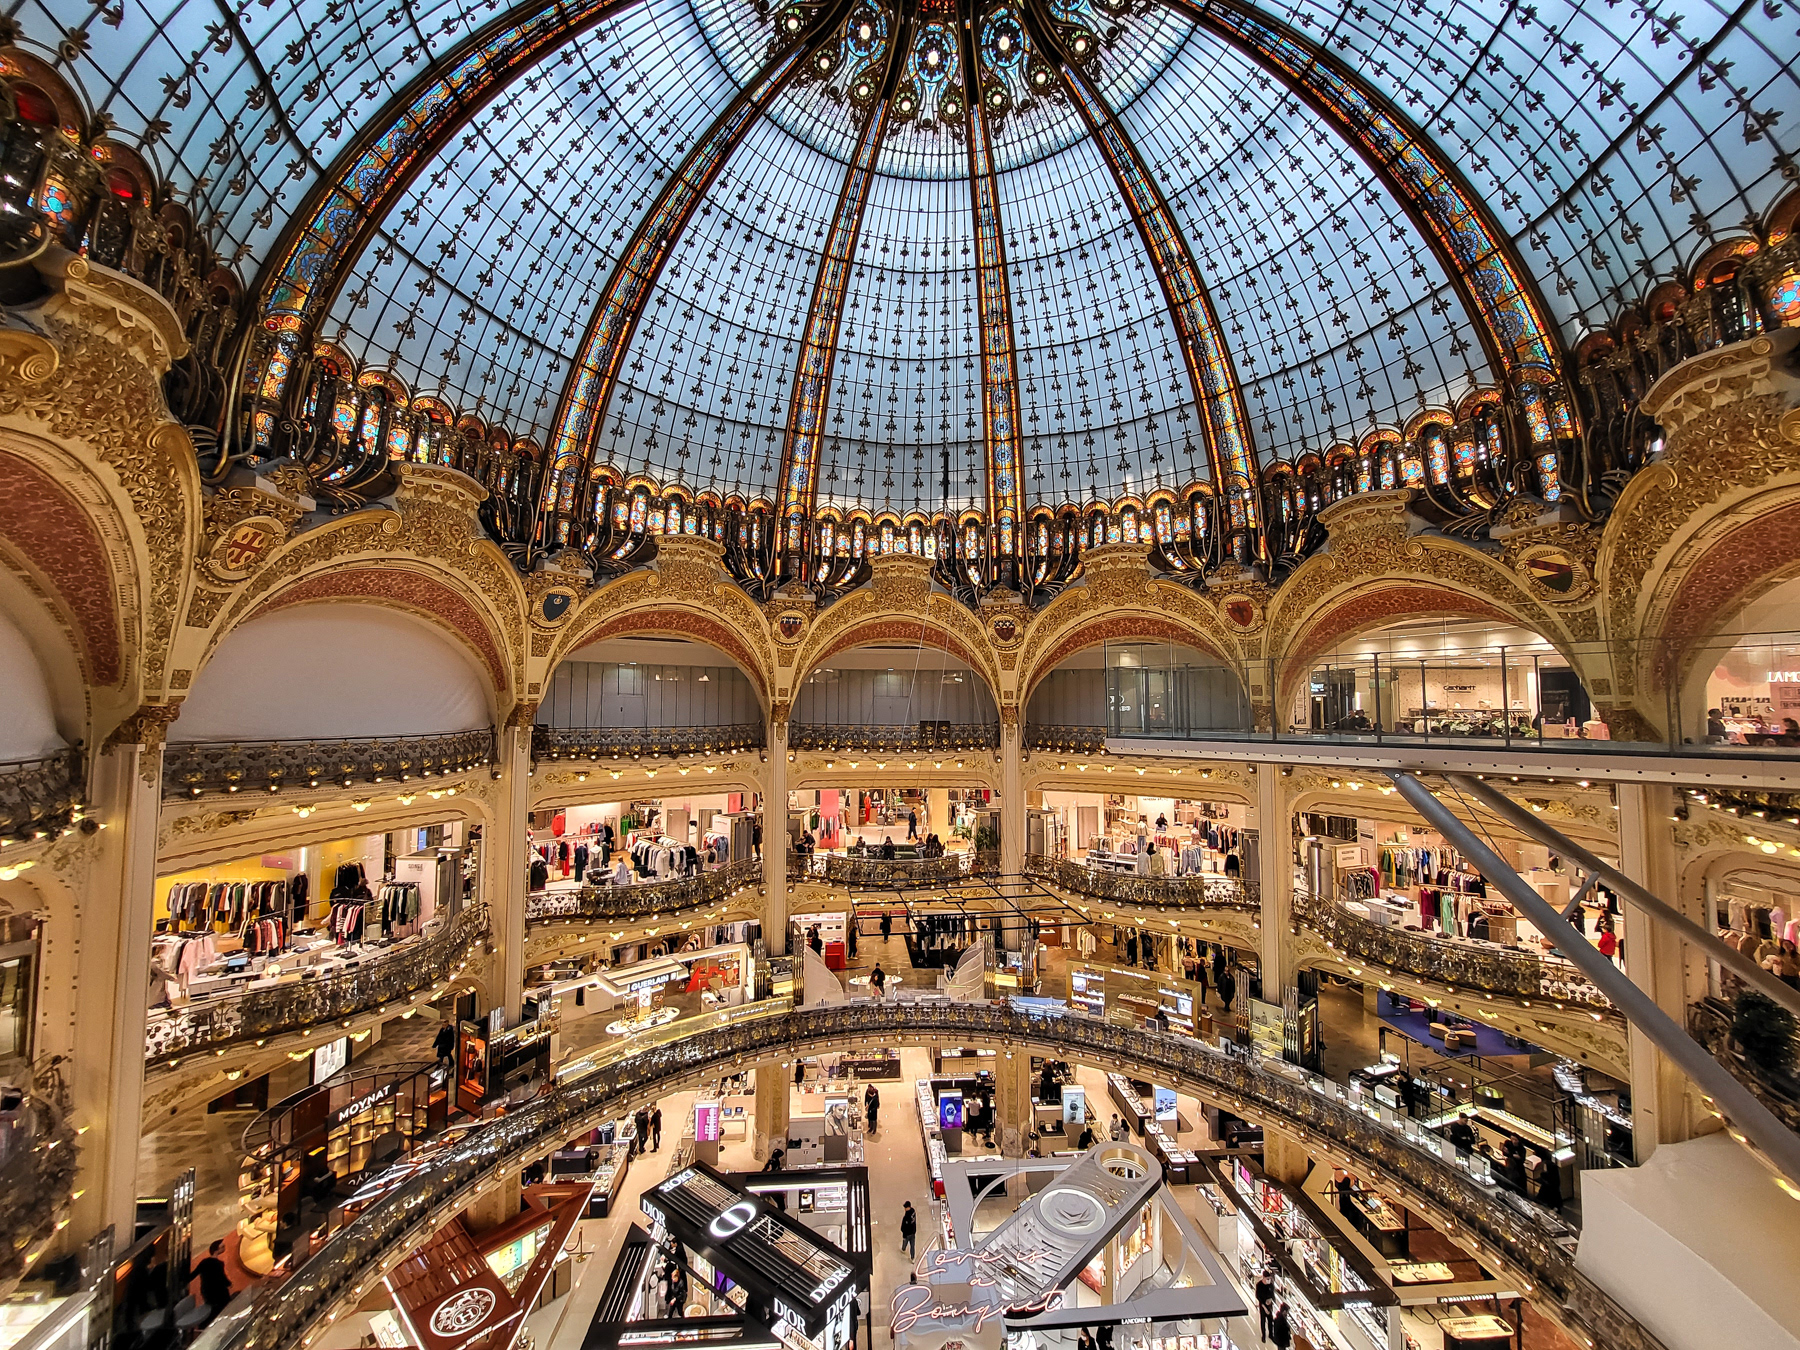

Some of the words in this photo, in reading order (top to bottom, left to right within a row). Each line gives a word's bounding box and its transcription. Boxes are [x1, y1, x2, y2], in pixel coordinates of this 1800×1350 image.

[630, 974, 670, 992] GUERLAIN
[338, 1084, 391, 1122] MOYNAT
[658, 1167, 696, 1193] DIOR
[642, 1198, 666, 1228] DIOR
[915, 1236, 1004, 1277] Love
[1016, 1249, 1053, 1263] is
[809, 1265, 850, 1304] DIOR
[969, 1275, 997, 1287] a
[773, 1296, 807, 1336] DIOR
[825, 1283, 858, 1325] DIOR
[890, 1281, 1068, 1334] Bouquet
